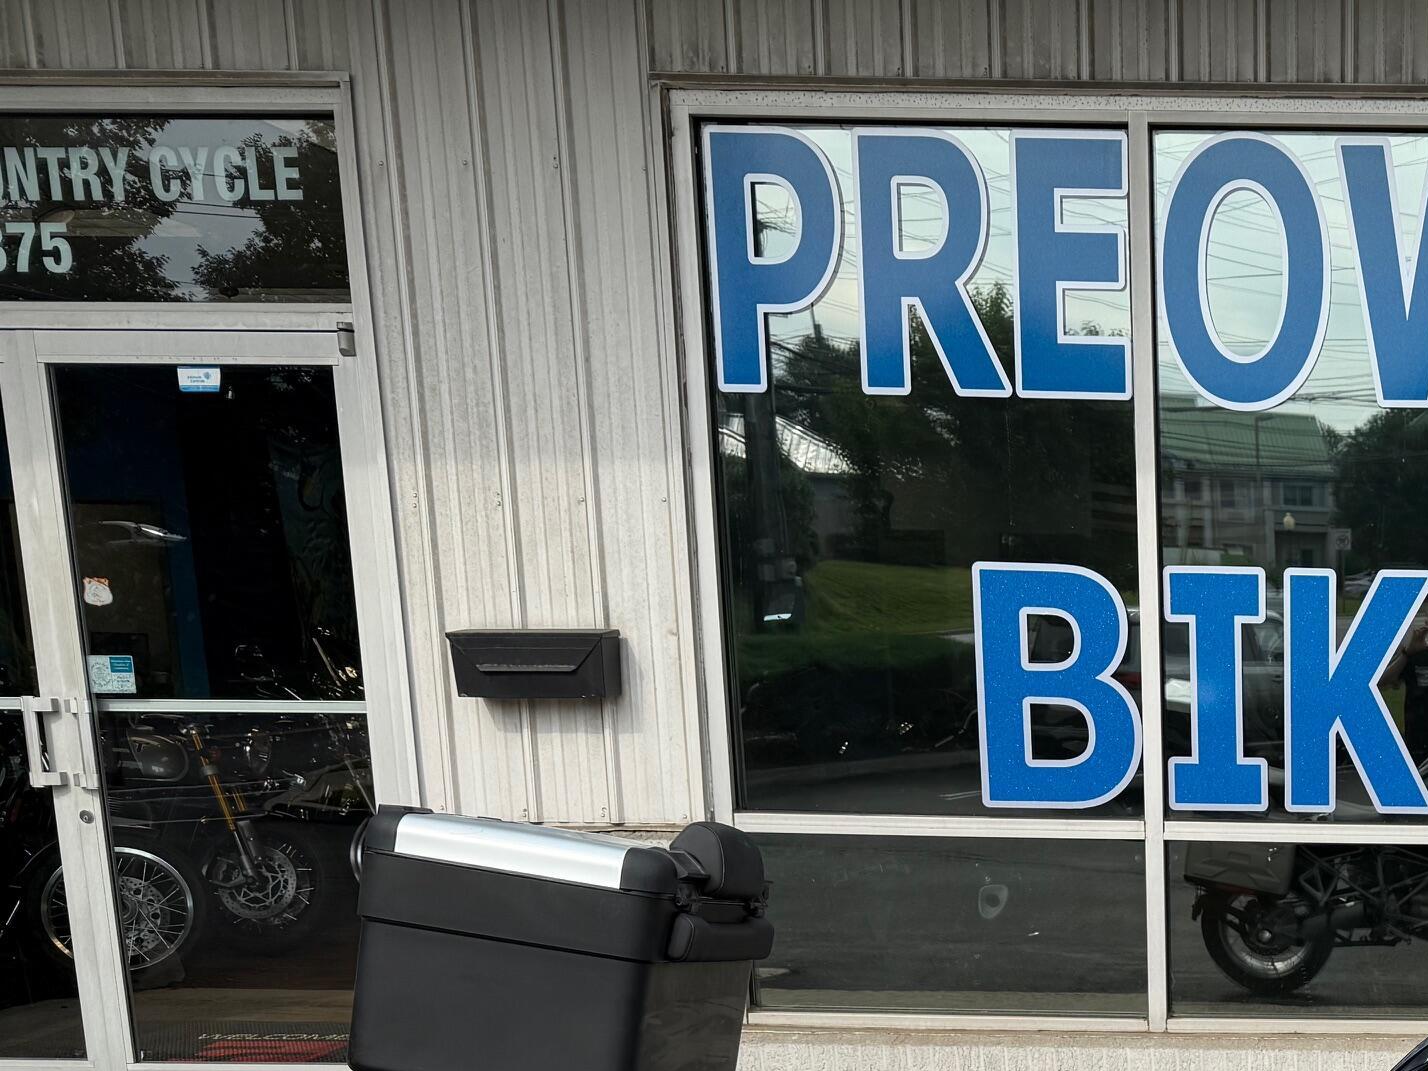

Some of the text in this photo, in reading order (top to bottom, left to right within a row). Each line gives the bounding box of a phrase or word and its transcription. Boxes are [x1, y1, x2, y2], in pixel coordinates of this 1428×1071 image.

[0, 145, 304, 202] NTRY CYCLE
[0, 222, 73, 274] 75
